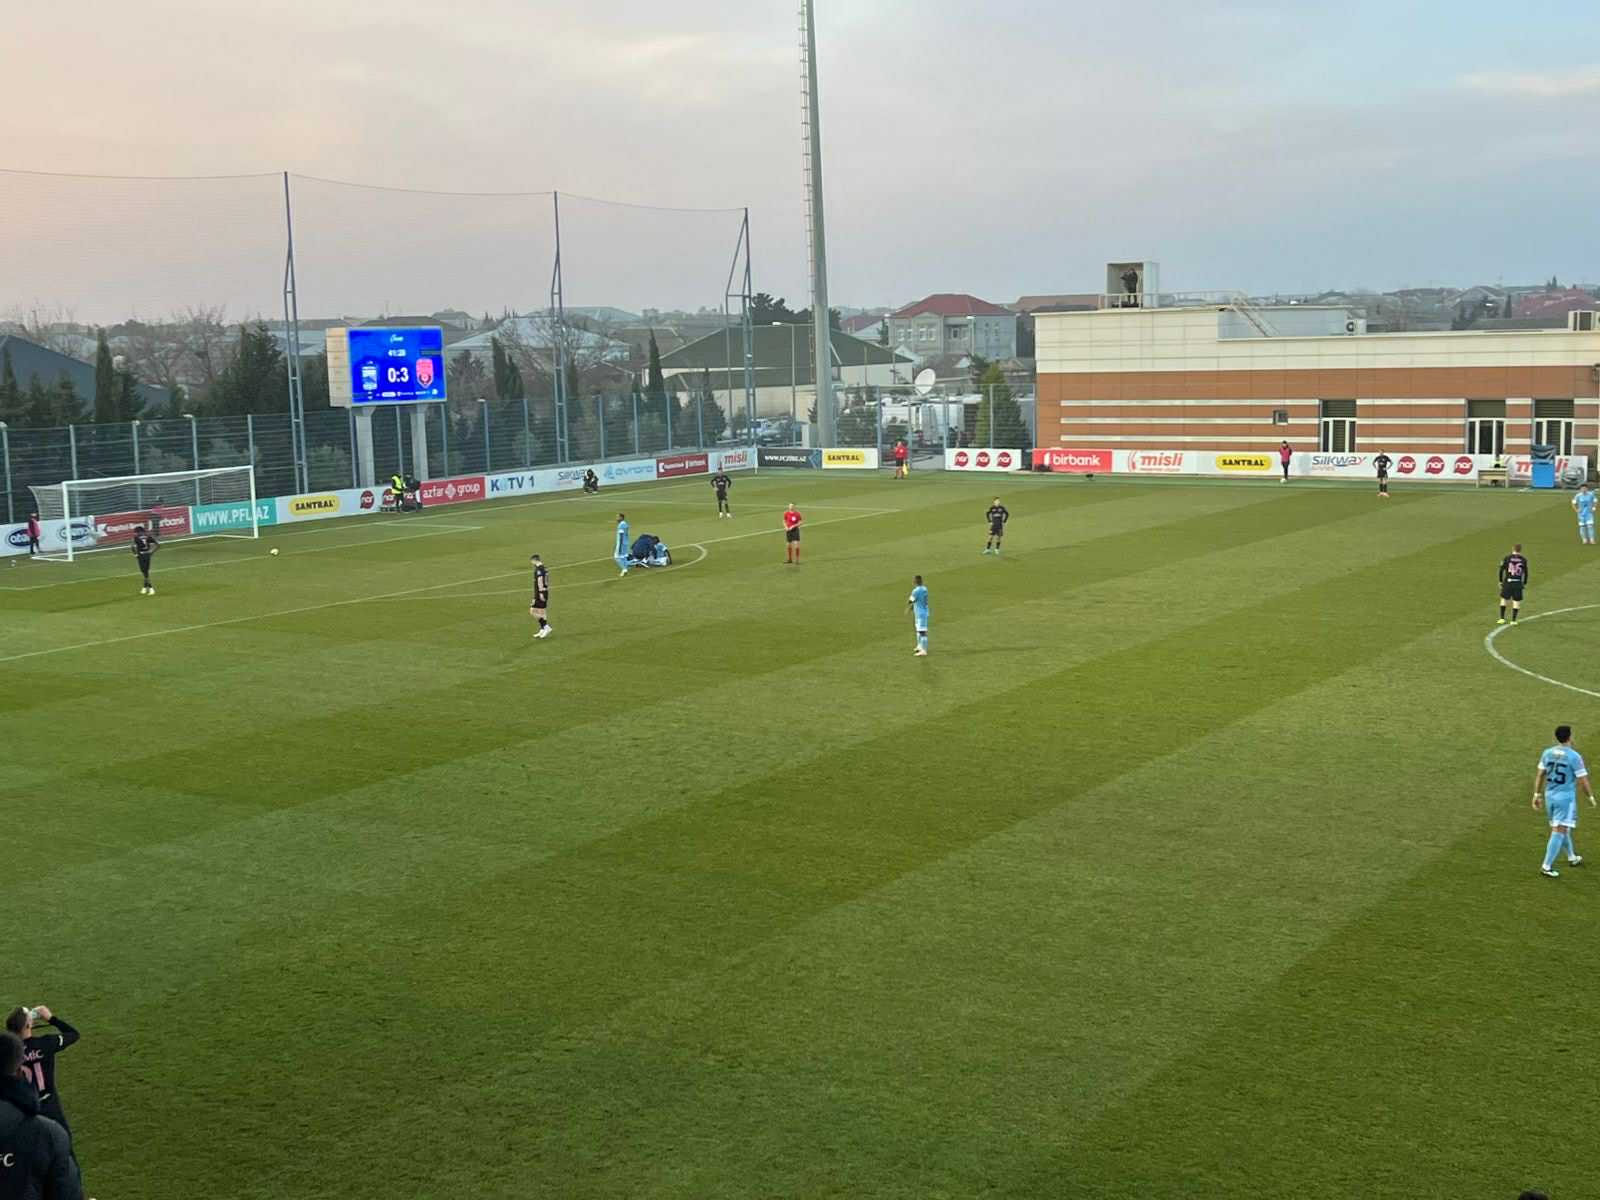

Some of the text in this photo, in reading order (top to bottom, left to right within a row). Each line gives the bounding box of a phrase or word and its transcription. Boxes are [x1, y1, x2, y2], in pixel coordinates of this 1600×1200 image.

[387, 367, 409, 383] 0:3
[1052, 453, 1101, 466] birbank
[1139, 453, 1184, 466] misli
[1222, 459, 1265, 467] SANTRAL
[423, 482, 480, 498] azfar group
[295, 500, 334, 511] SANTRAL
[197, 505, 270, 526] WWW.PFLAZ
[1546, 761, 1568, 785] 25
